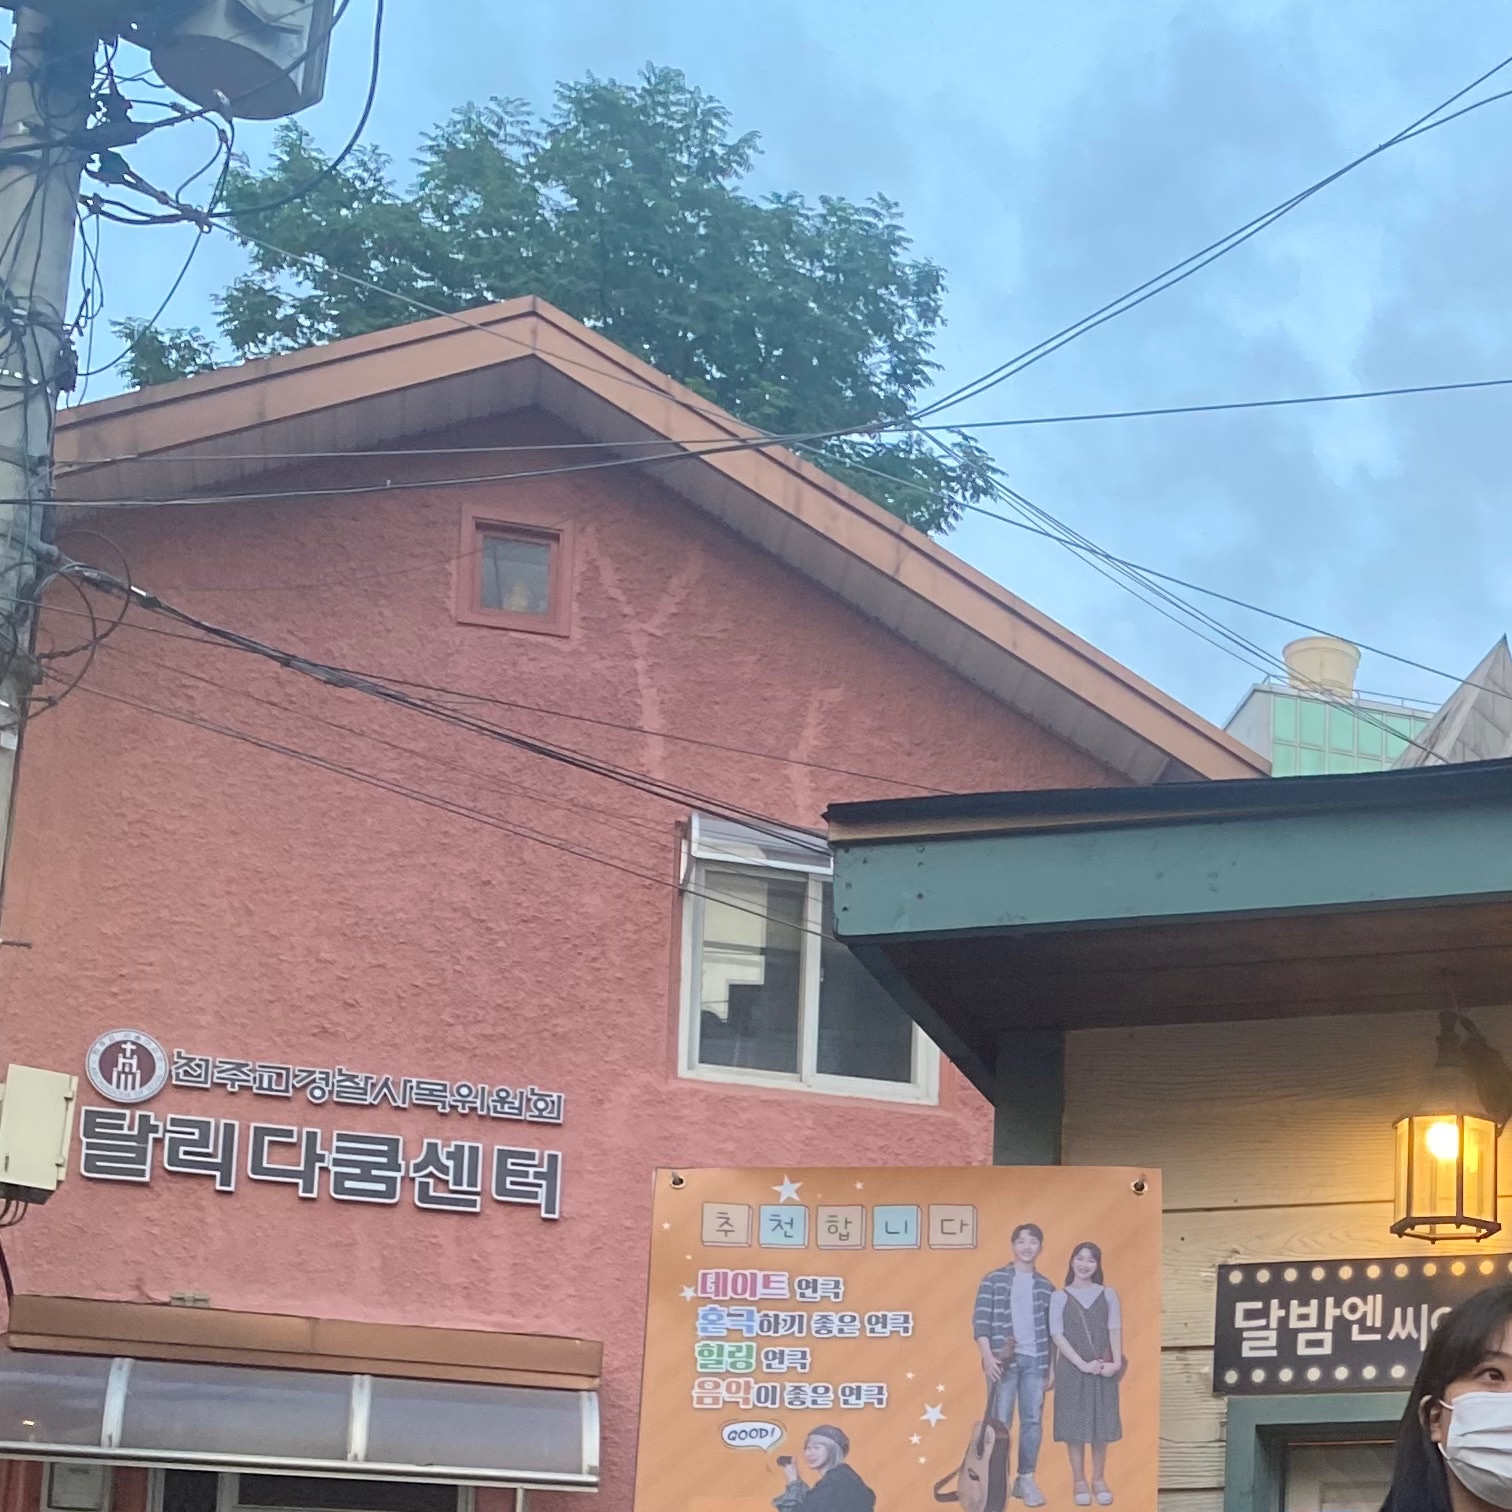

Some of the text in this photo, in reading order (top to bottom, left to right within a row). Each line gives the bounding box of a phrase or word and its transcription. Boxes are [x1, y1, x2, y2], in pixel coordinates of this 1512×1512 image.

[80, 1106, 563, 1220] 탈리다쿰센터
[698, 1269, 844, 1302] 데이트 연극
[812, 1312, 860, 1337] 좋은
[865, 1311, 913, 1337] 연극
[695, 1341, 811, 1373] 힐링 연극
[692, 1377, 888, 1409] 음악이 좋은 연극
[727, 1426, 776, 1442] GOOD!
